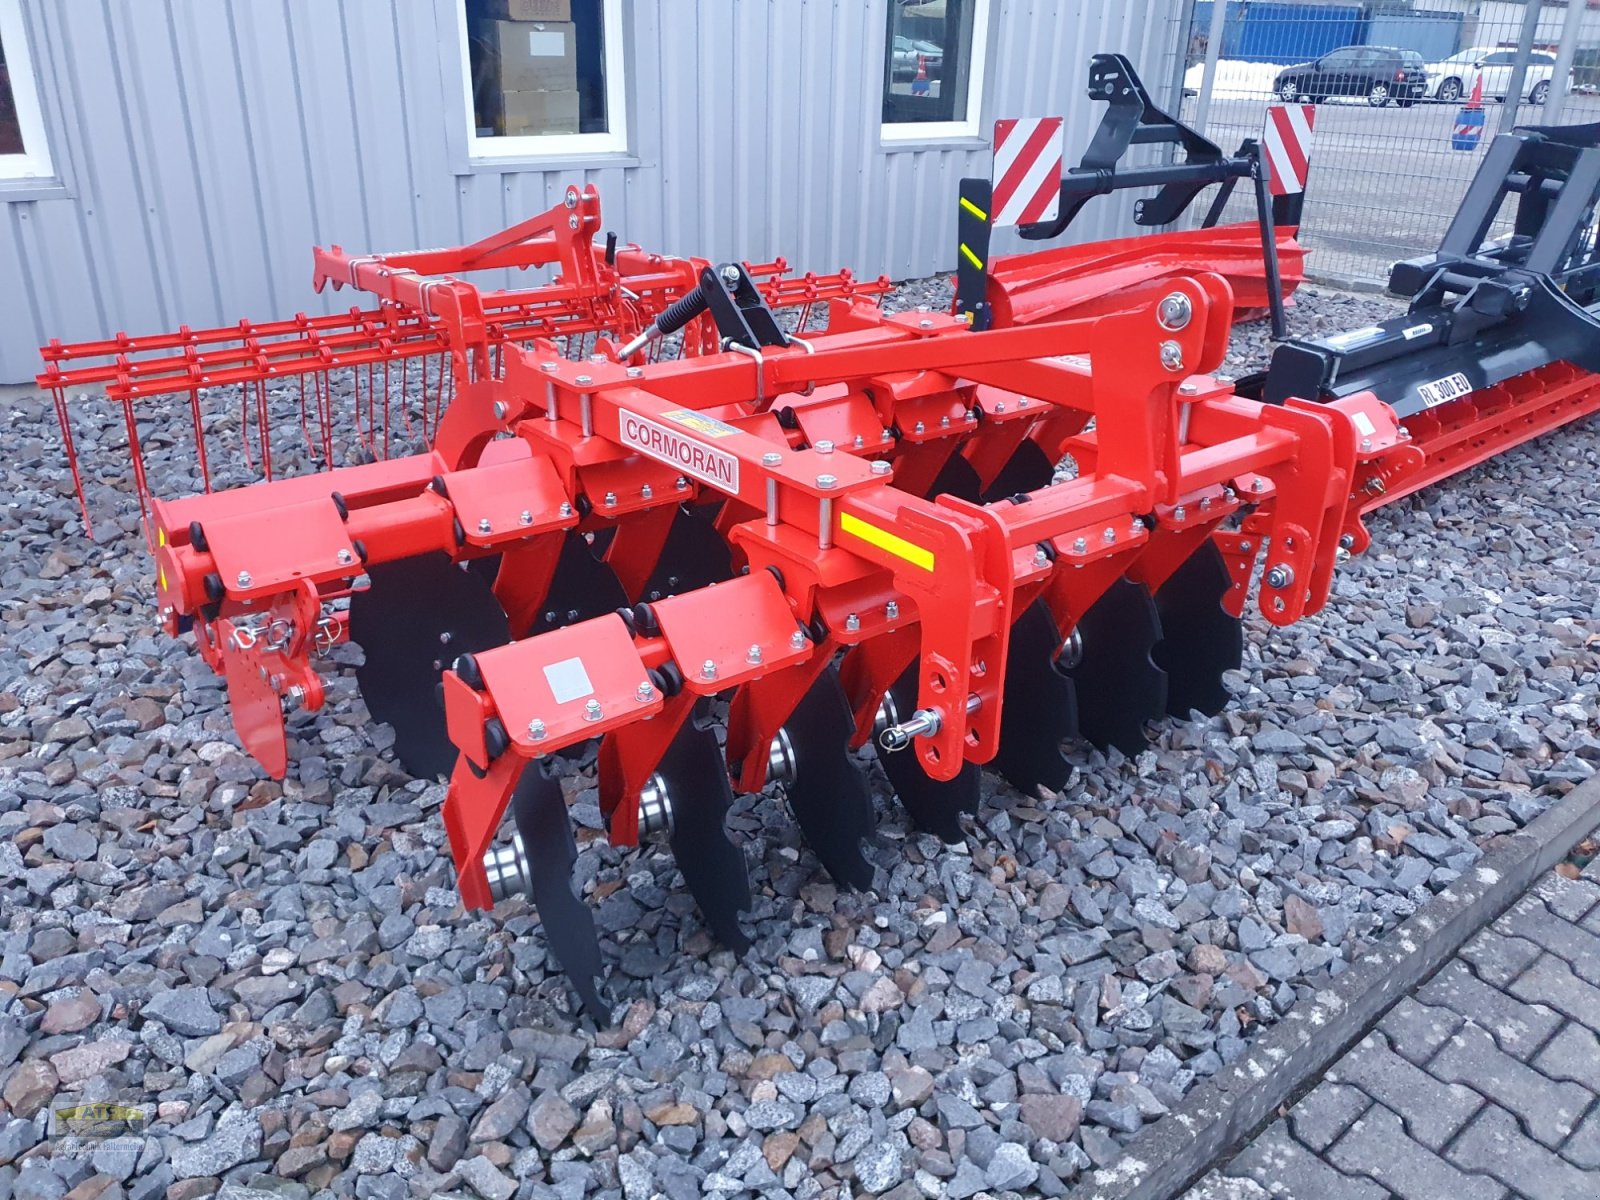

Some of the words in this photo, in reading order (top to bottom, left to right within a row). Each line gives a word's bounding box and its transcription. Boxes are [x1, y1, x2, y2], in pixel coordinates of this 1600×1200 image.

[1420, 388, 1438, 404] RL
[1434, 380, 1456, 399] 300
[1452, 374, 1469, 392] EU
[626, 418, 731, 483] CORMORAN
